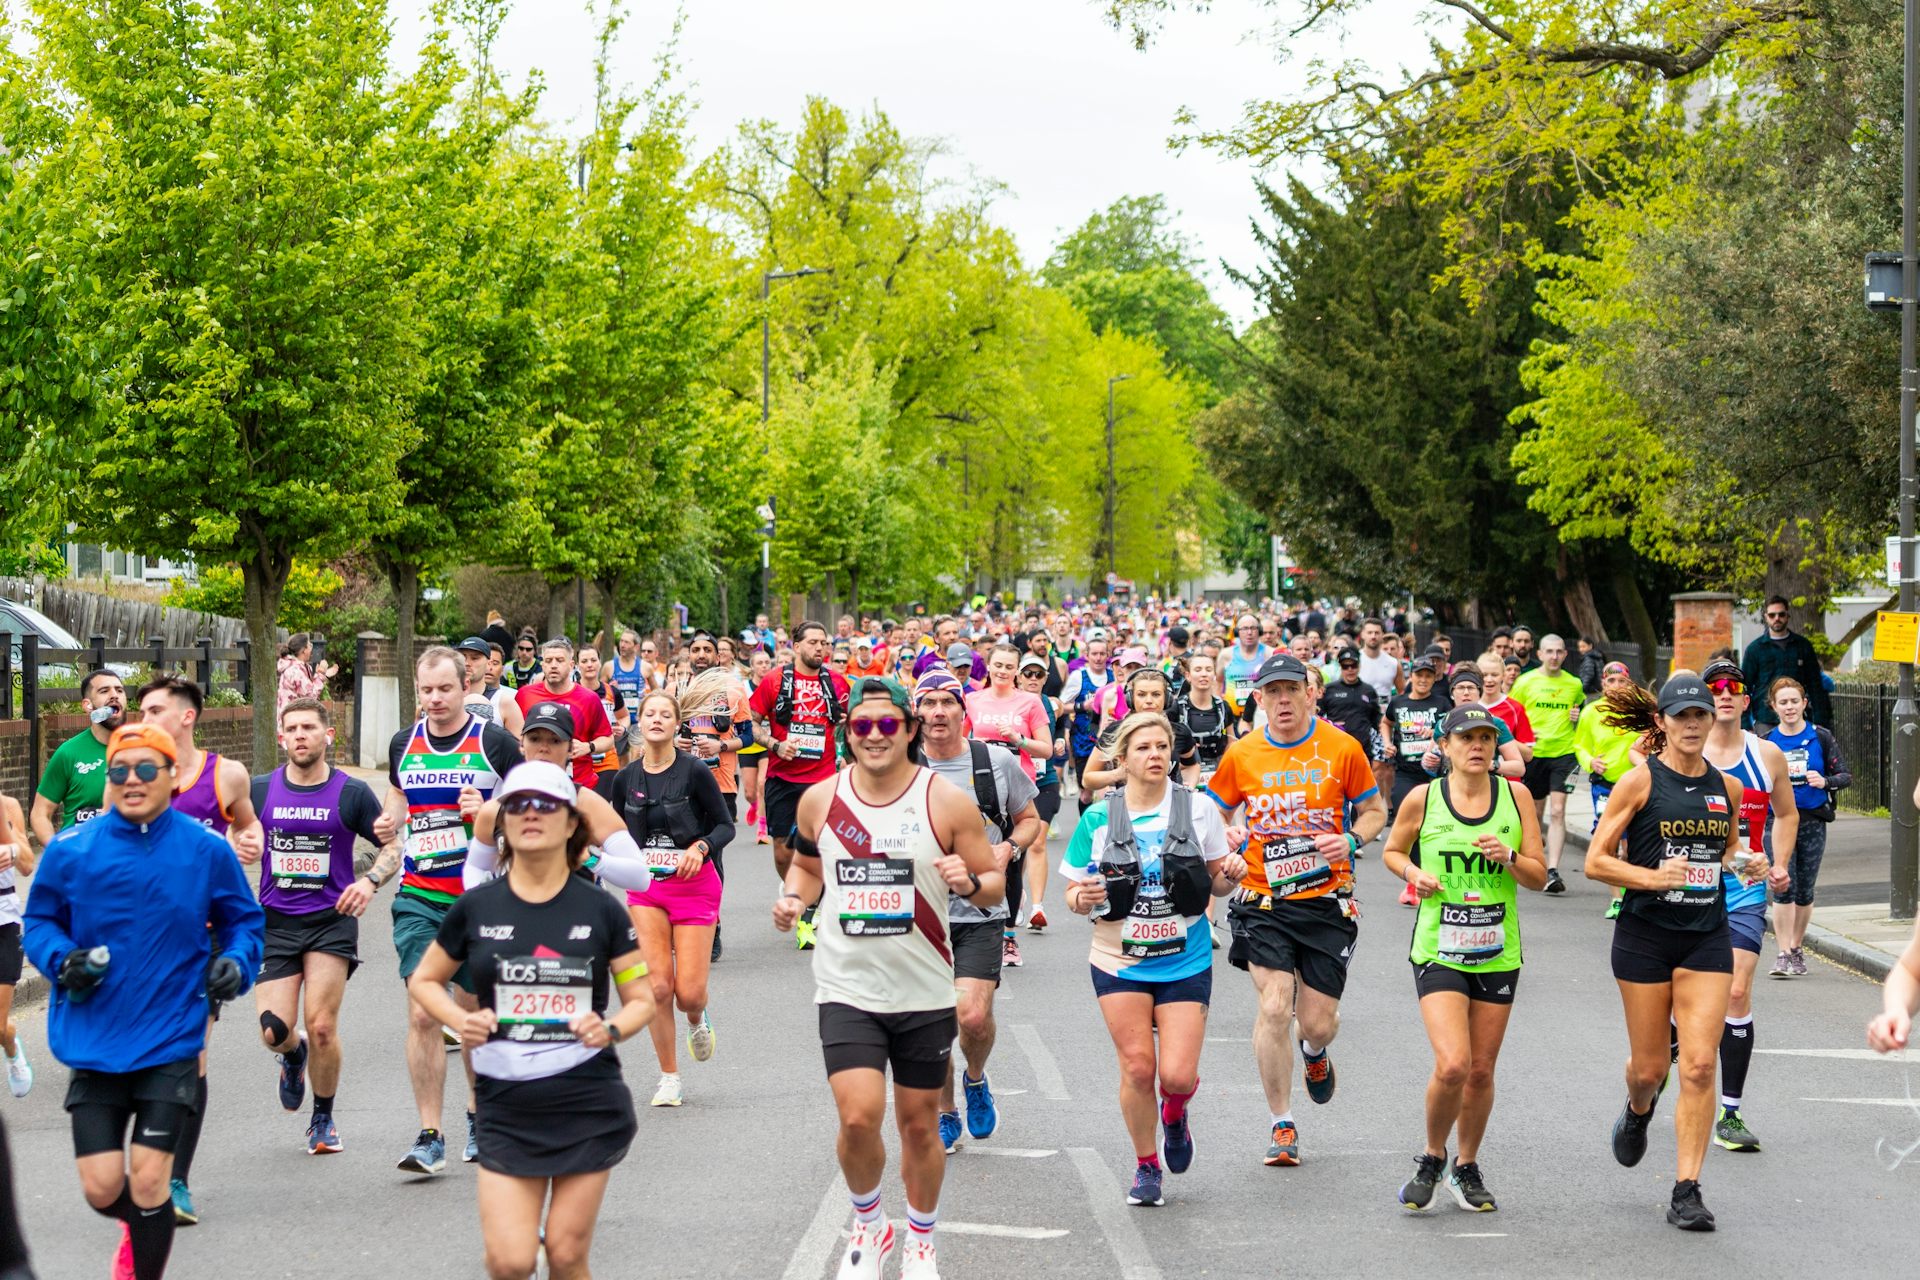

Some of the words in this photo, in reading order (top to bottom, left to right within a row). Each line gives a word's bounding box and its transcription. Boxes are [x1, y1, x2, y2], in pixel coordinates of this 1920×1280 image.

[794, 679, 822, 691] RIZZ
[974, 712, 1023, 726] Jessie
[1398, 711, 1436, 723] SANDRA
[1465, 711, 1486, 719] TYM
[790, 723, 804, 733] tcs
[406, 773, 475, 785] ANDREW
[1263, 769, 1323, 788] STEVE
[76, 809, 95, 821] tcs
[272, 806, 331, 821] MACAWLEY
[1260, 807, 1335, 828] ANCER
[412, 817, 429, 831] tcs
[1660, 820, 1730, 838] ROSARIO
[273, 834, 294, 850] tcs
[419, 832, 457, 852] 25111
[1287, 840, 1315, 850] CONSULTAN
[1266, 844, 1288, 859] tcs
[1665, 842, 1690, 857] tcs
[279, 858, 320, 872] 18366
[444, 858, 466, 867] balance
[646, 852, 679, 866] 24025
[1438, 851, 1504, 875] TYM
[840, 863, 866, 882] tcs
[1275, 855, 1317, 879] 20267
[1439, 874, 1502, 889] RUNNING
[1683, 868, 1714, 884] 693
[848, 891, 902, 910] 21669
[1151, 903, 1175, 911] CONSULT
[1443, 906, 1468, 923] tcs
[479, 926, 496, 938] tcs
[880, 926, 907, 934] balance
[1131, 922, 1178, 939] 20566
[1450, 930, 1497, 947] 16440
[1160, 947, 1181, 956] balance
[502, 960, 537, 983] tcs
[538, 961, 561, 969] TATA
[538, 968, 587, 977] CONSULTANCY
[538, 976, 570, 984] SERVICES
[512, 994, 576, 1015] 23768
[534, 1032, 550, 1041] new
[550, 1031, 576, 1041] balan
